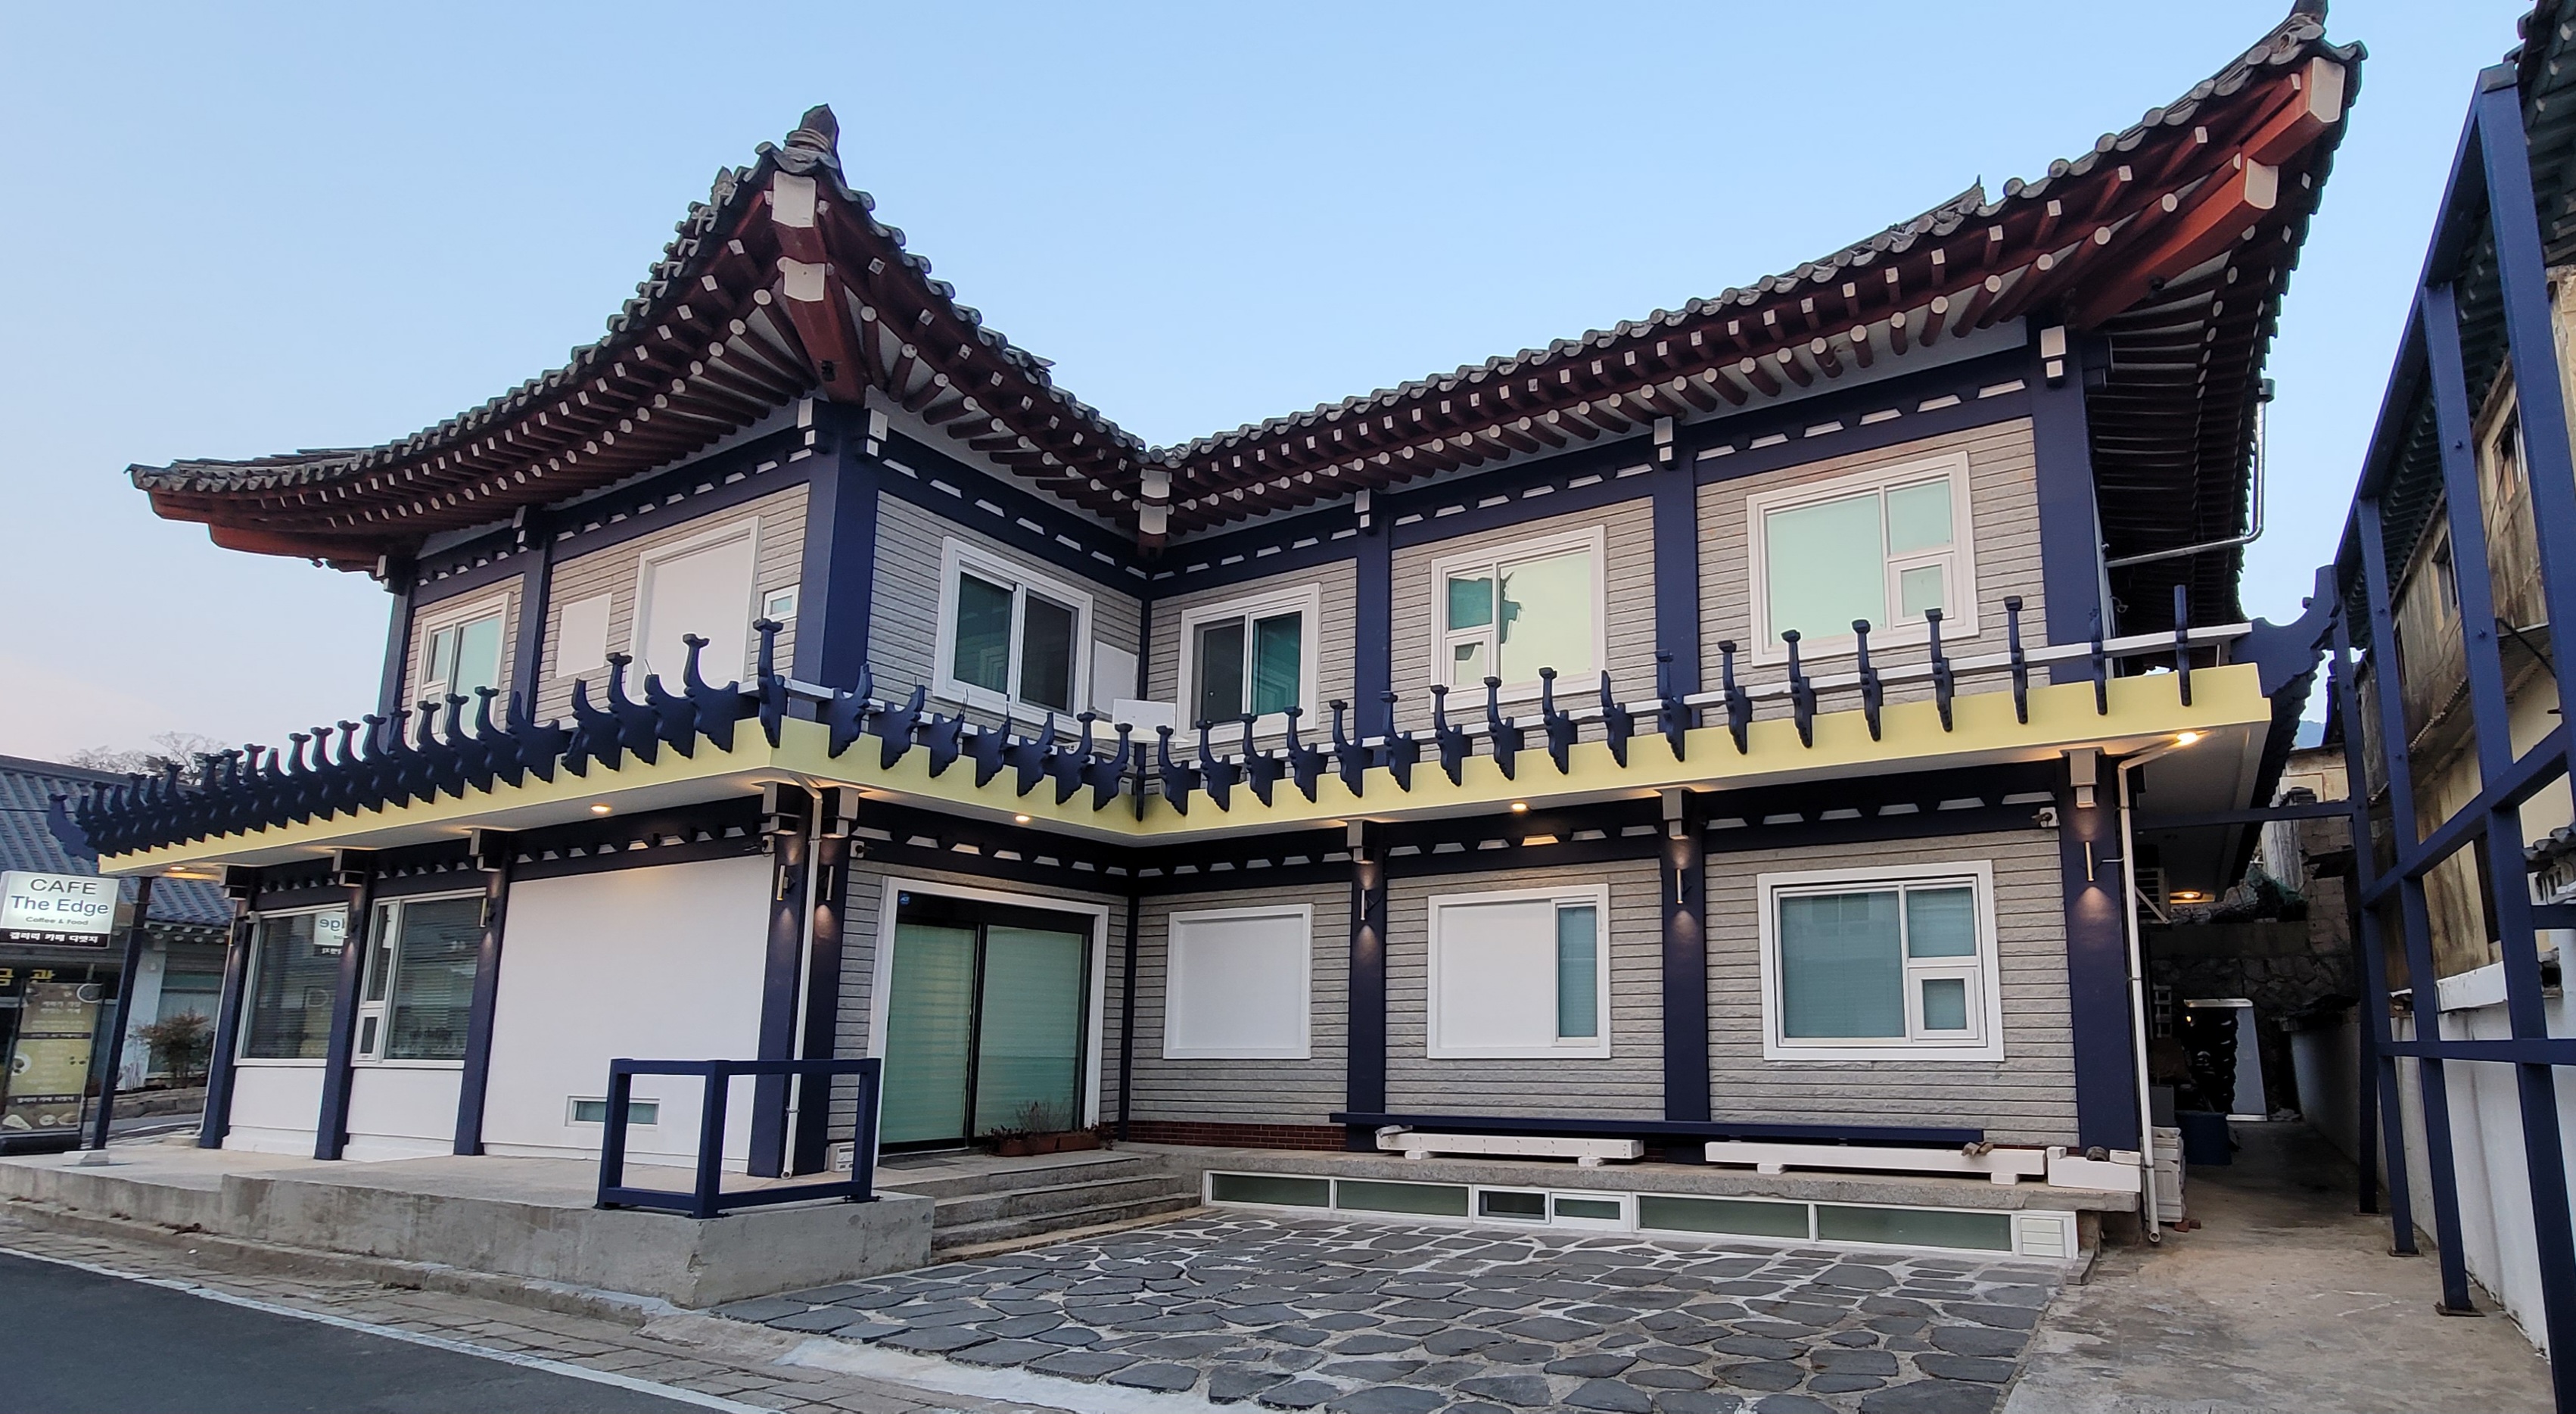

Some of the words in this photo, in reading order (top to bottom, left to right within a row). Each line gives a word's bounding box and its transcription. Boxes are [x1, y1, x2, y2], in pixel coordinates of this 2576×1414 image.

[30, 878, 98, 895] CAFE
[11, 895, 50, 911] The
[57, 899, 108, 917] Edge
[26, 916, 56, 924] Coffee
[45, 933, 65, 942] 카페
